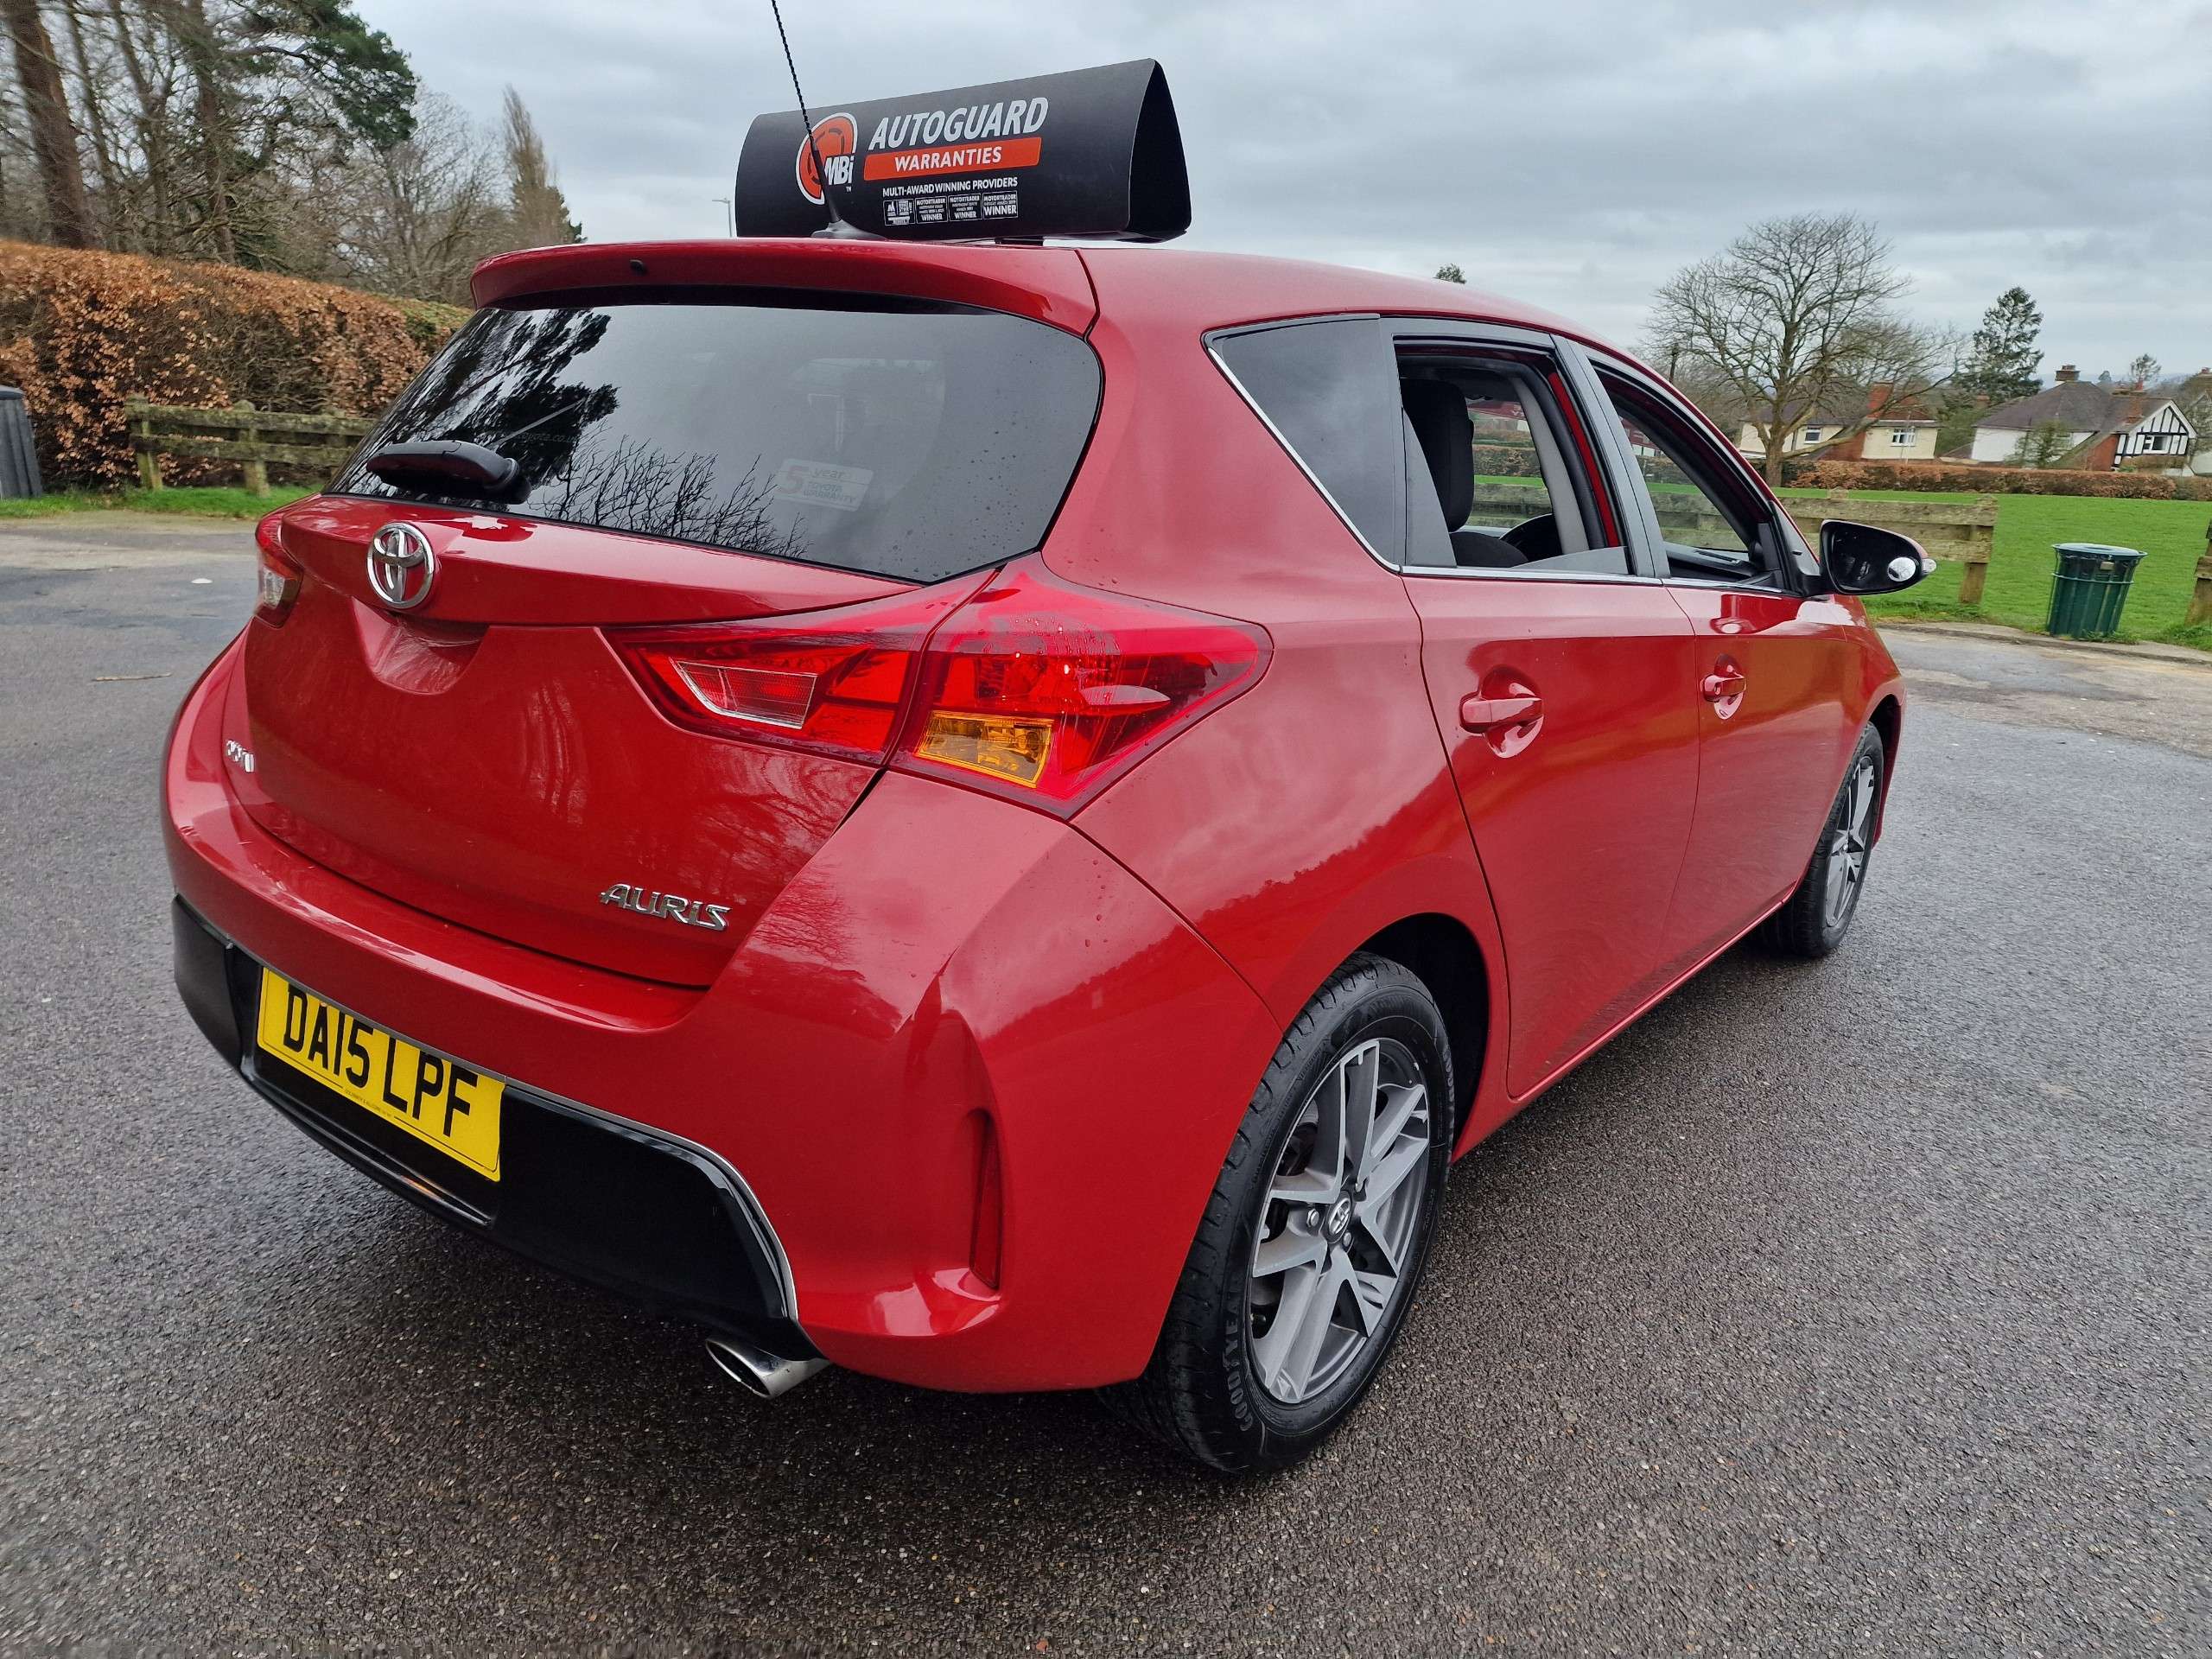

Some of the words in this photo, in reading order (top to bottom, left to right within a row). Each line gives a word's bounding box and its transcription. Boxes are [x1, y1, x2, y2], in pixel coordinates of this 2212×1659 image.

[868, 97, 1049, 151] AUTOGUARD
[894, 146, 1002, 172] WARRANTIES
[935, 181, 971, 193] WINNING
[972, 176, 1018, 188] PROVIDERS
[954, 211, 976, 219] WINNER
[983, 205, 1017, 216] WINNER
[600, 883, 732, 931] AURIS
[283, 982, 374, 1090] DA15
[383, 1036, 479, 1138] LPF
